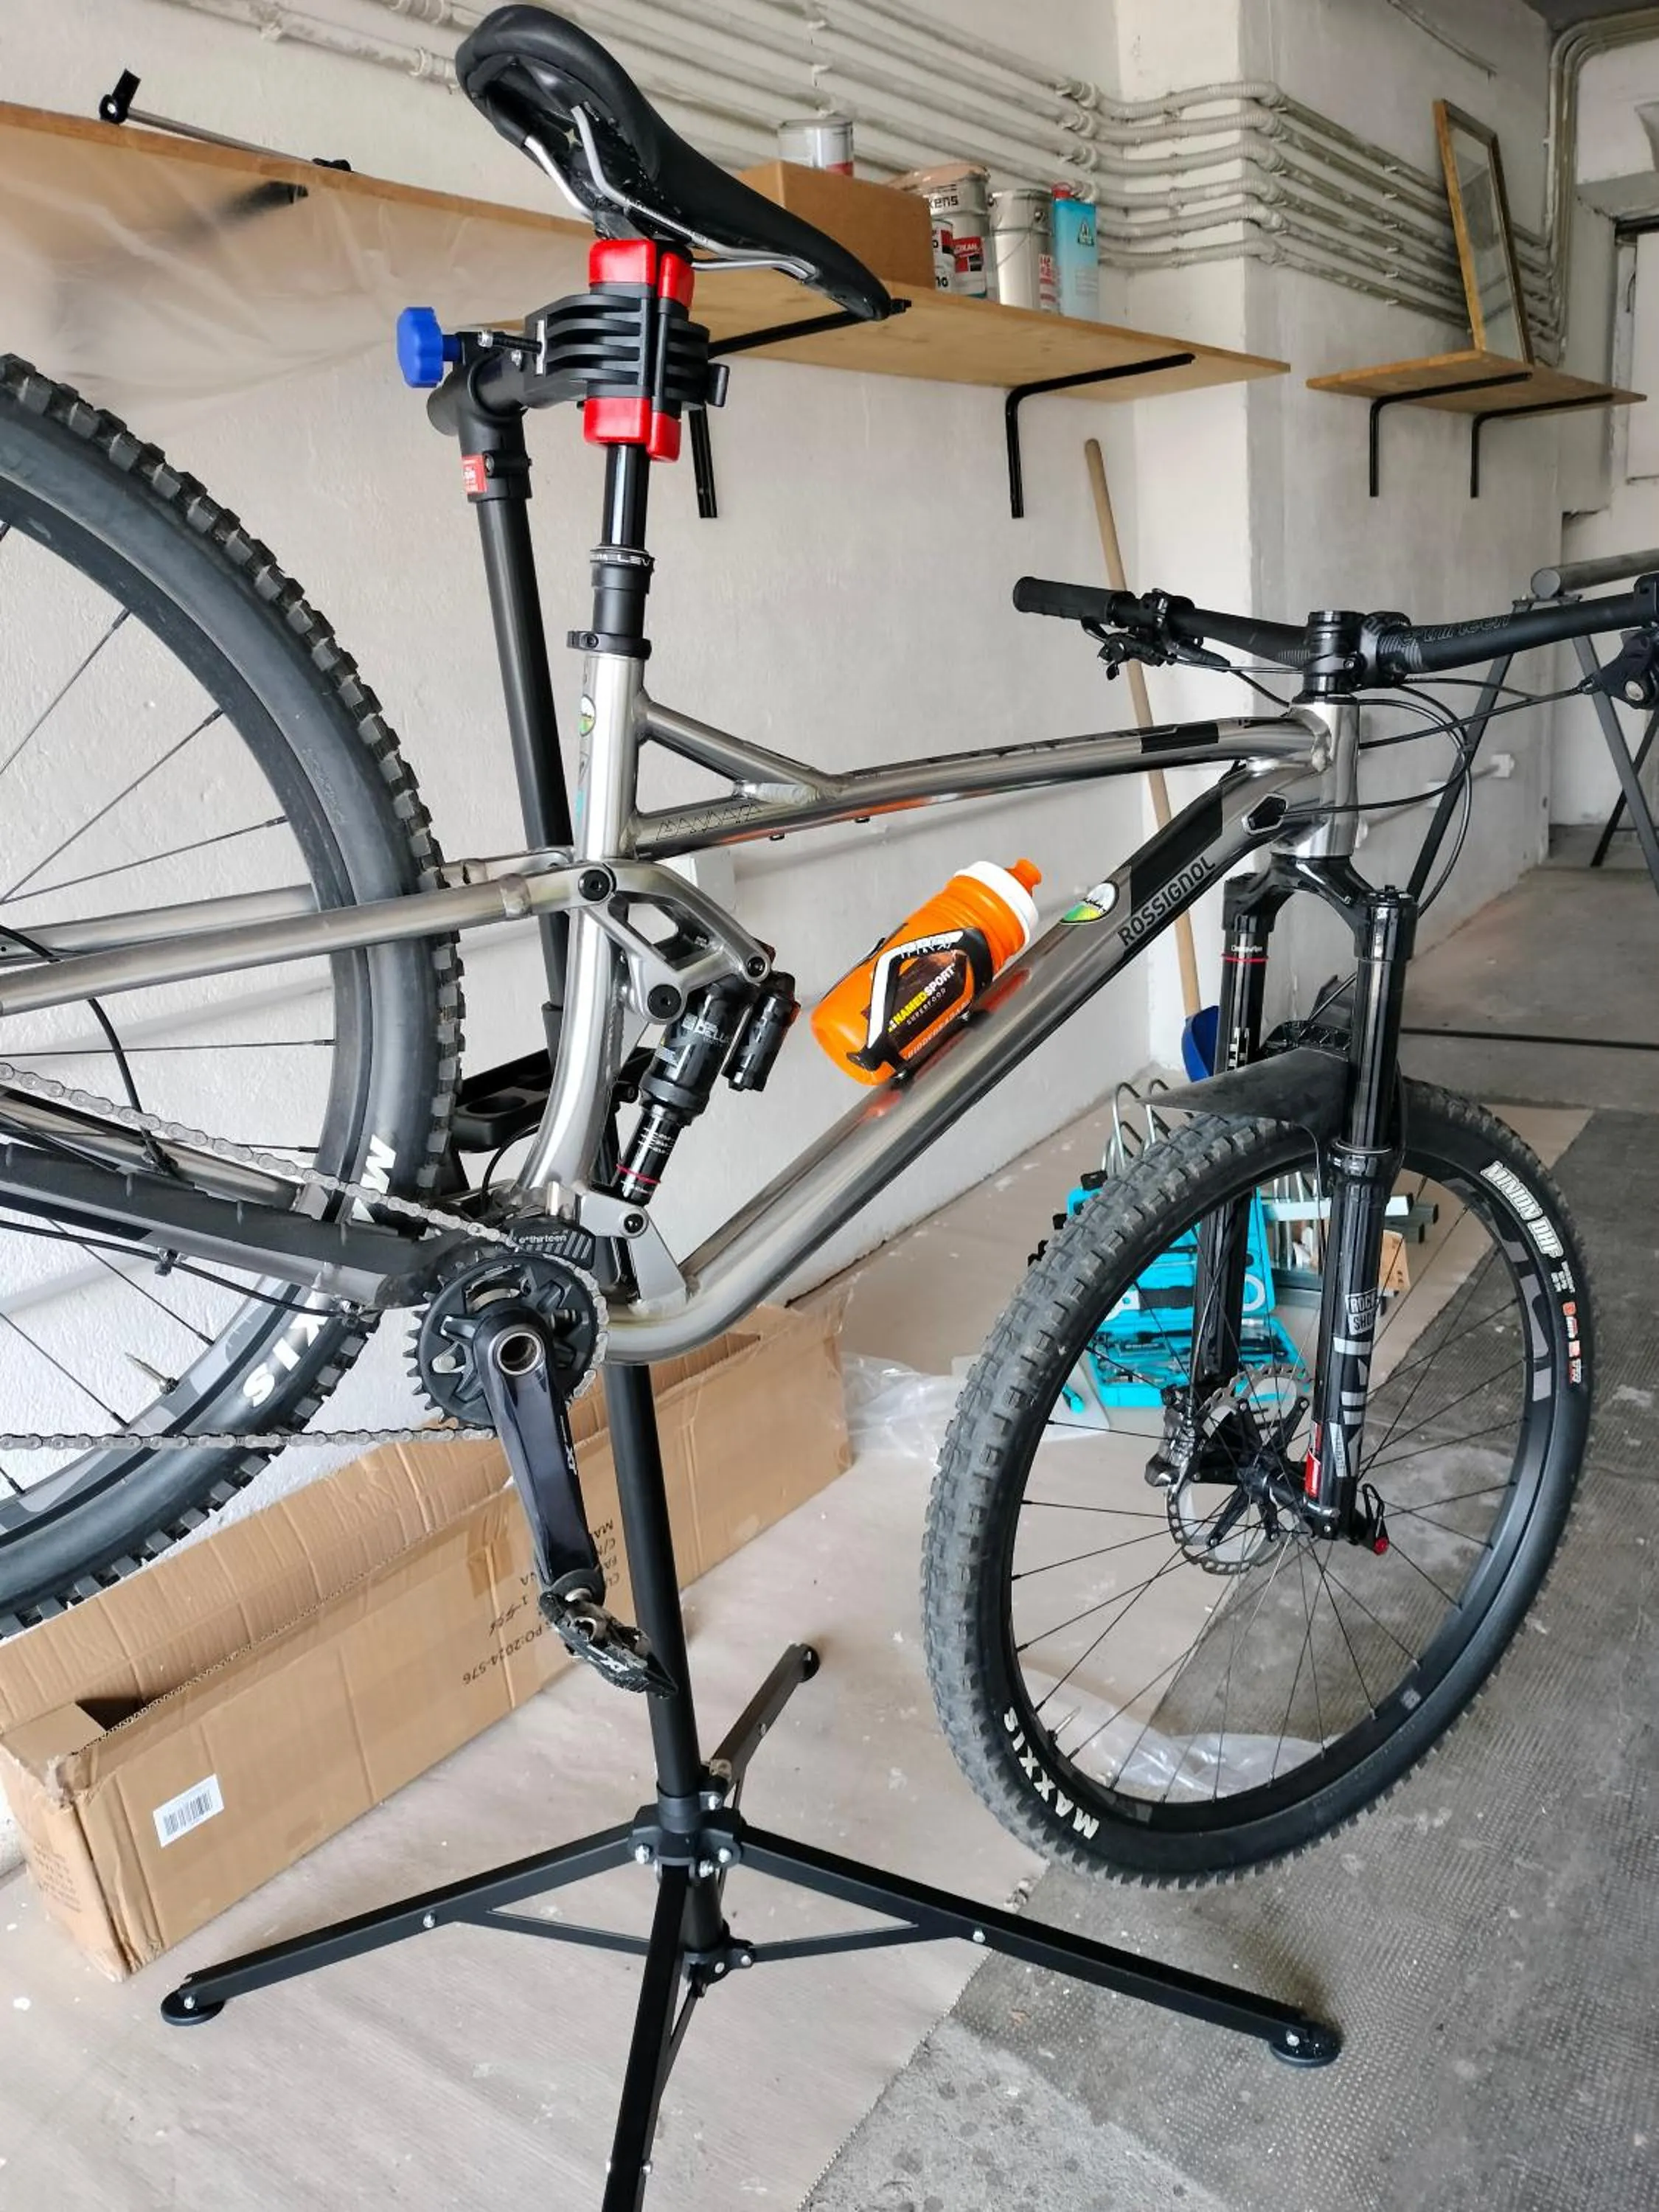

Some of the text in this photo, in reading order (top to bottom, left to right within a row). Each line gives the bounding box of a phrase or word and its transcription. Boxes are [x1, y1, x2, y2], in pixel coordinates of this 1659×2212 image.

[1116, 856, 1217, 947] ROSSIGNOL
[1481, 1160, 1543, 1221] MINION
[1527, 1216, 1565, 1259] DHF
[1003, 1706, 1100, 1840] MAXXIS
